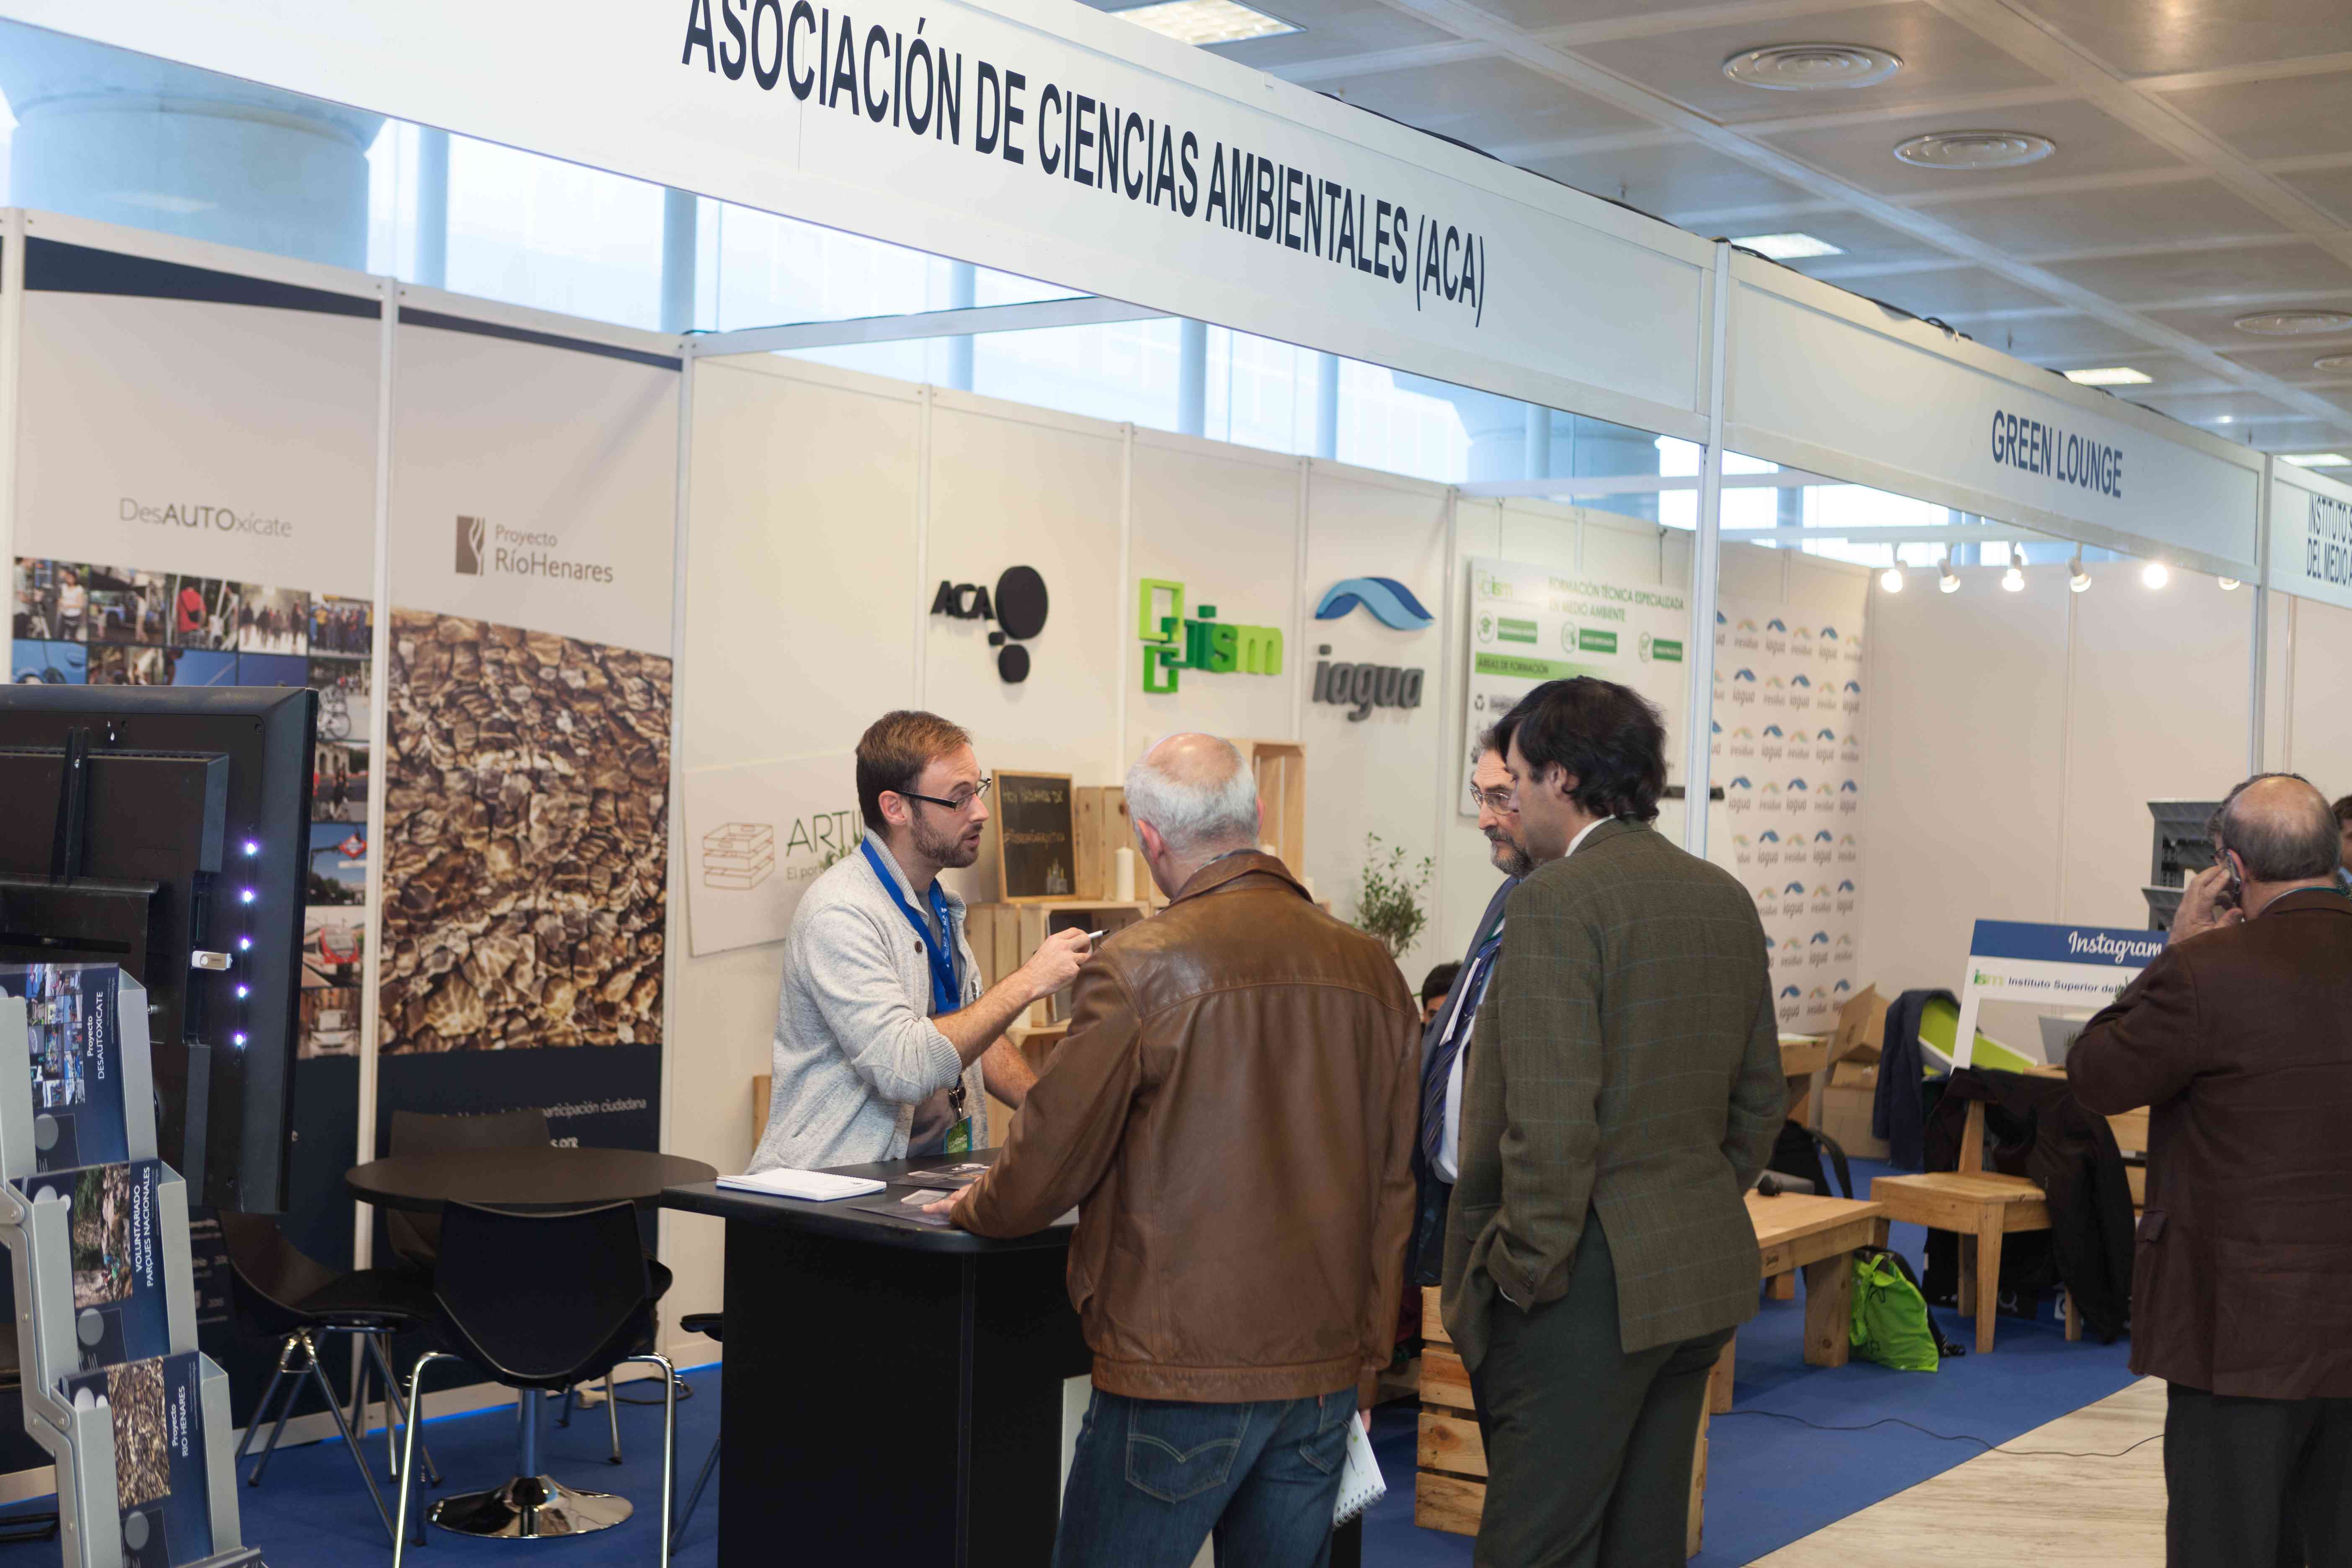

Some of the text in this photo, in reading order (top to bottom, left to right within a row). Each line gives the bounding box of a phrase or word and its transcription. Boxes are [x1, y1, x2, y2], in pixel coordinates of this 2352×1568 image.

[682, 0, 1484, 328] ASOCIACIÓN DE CIENCIAS AMBIENTALES (ACA)
[1992, 410, 2122, 498] GREEN LOUNGE
[120, 497, 292, 538] DesAUTOxícate
[495, 524, 557, 547] Proyecto
[2308, 492, 2347, 543] INSTITUTO
[495, 547, 613, 583] RíoHenares
[2307, 536, 2321, 579] DEL
[2324, 542, 2347, 586] MEDIO
[930, 581, 995, 620] ACA
[1313, 644, 1424, 722] iagua
[2068, 931, 2162, 964] Instagram
[2009, 976, 2050, 988] Instituto
[2054, 980, 2099, 993] Superior
[96, 991, 105, 1079] DESAUTOXICATE
[601, 1098, 647, 1113] ciudadana
[134, 1185, 142, 1273] VOLUNTARIADO
[144, 1238, 153, 1287] PARQUES
[179, 1385, 187, 1435] HENARES
